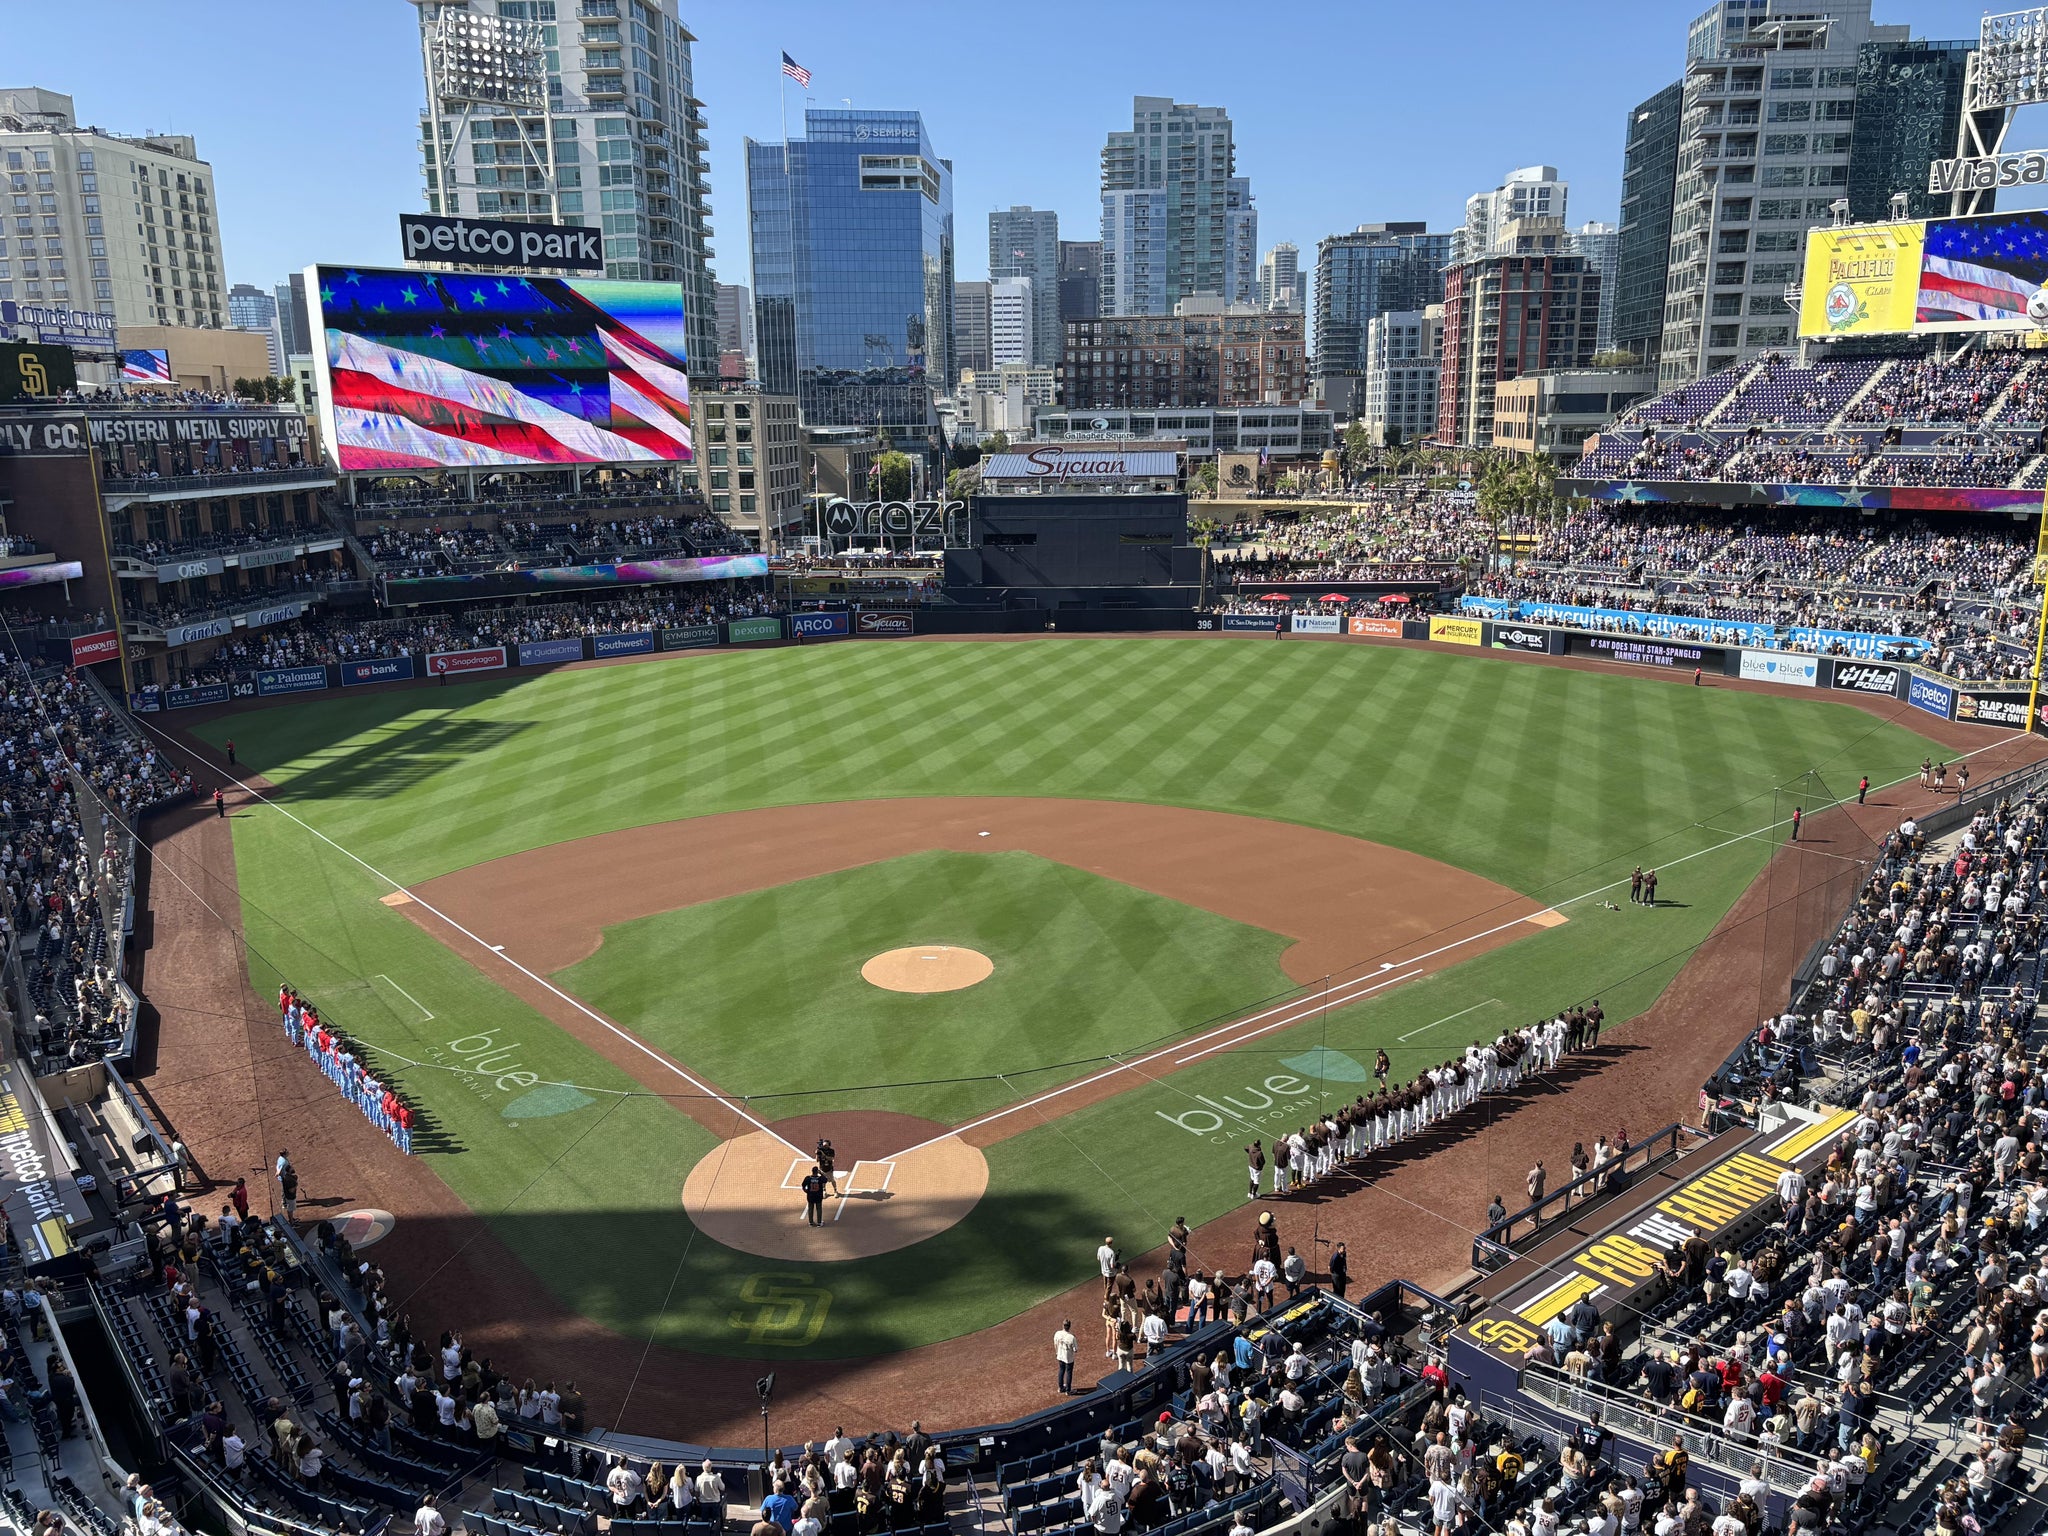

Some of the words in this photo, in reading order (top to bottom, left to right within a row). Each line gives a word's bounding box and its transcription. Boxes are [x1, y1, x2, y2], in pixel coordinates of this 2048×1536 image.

[872, 127, 917, 138] SEMPRA
[1934, 154, 2048, 192] Viasa
[405, 220, 515, 258] petco
[519, 231, 600, 264] park
[21, 305, 114, 331] QuidelOrtho
[44, 423, 87, 449] CO.
[88, 420, 169, 442] WESTERN
[175, 419, 227, 440] METAL
[228, 418, 279, 439] SUPPLY
[285, 418, 308, 438] CO.
[1064, 431, 1105, 440] Gallagher
[1105, 431, 1135, 440] Square
[1026, 446, 1128, 484] Sycuan
[862, 500, 965, 536] razr
[178, 562, 208, 578] ORIS
[259, 606, 294, 625] Canel's
[860, 613, 908, 632] Sycuan
[180, 621, 222, 642] Canel's
[794, 618, 833, 632] ARCO
[1197, 620, 1213, 630] 396
[1446, 625, 1478, 634] MERCURY
[1446, 631, 1478, 640] INSURANCE
[1499, 630, 1543, 644] EVOTEK
[82, 641, 106, 653] MISSION
[106, 639, 118, 648] FED
[130, 645, 146, 658] 336
[534, 645, 580, 657] QuidelOrtho
[598, 638, 644, 651] Southwest
[1598, 640, 1610, 649] SAY
[1611, 642, 1628, 651] DOES
[1629, 643, 1646, 653] THAT
[1647, 645, 1701, 660] STAR-SPANGLED
[451, 655, 498, 667] Snapdragon
[1614, 651, 1641, 662] BANNER
[1642, 654, 1654, 663] YET
[1655, 656, 1674, 666] WAVE
[1743, 658, 1766, 670] blue
[357, 668, 370, 676] us
[371, 663, 399, 675] bank
[1780, 662, 1804, 674] blue
[277, 670, 323, 683] Palomar
[233, 683, 255, 697] 342
[263, 682, 297, 692] SPECIALTY
[298, 679, 324, 688] INSURANCE
[1854, 681, 1893, 692] POWER
[1921, 687, 1948, 706] petco
[1979, 700, 2002, 712] SLAP
[2003, 703, 2030, 714] SOME
[1978, 711, 2007, 722] CHEESE
[2007, 714, 2019, 723] ON
[446, 1028, 539, 1091] blue
[424, 1045, 492, 1101] CALIFORNIA
[1154, 1075, 1310, 1137] blue
[1210, 1090, 1334, 1146] CALIFORNIA
[1572, 1234, 1668, 1288] FOR
[1626, 1213, 1695, 1250] THE
[1738, 1411, 1750, 1423] 27
[1584, 1434, 1598, 1445] 13
[1113, 1473, 1124, 1482] 23
[1504, 1468, 1517, 1480] 19
[1835, 1474, 1842, 1485] 9
[1173, 1481, 1187, 1490] 13
[1646, 1489, 1661, 1500] 23
[1629, 1501, 1640, 1515] 23
[1539, 1518, 1550, 1527] 23
